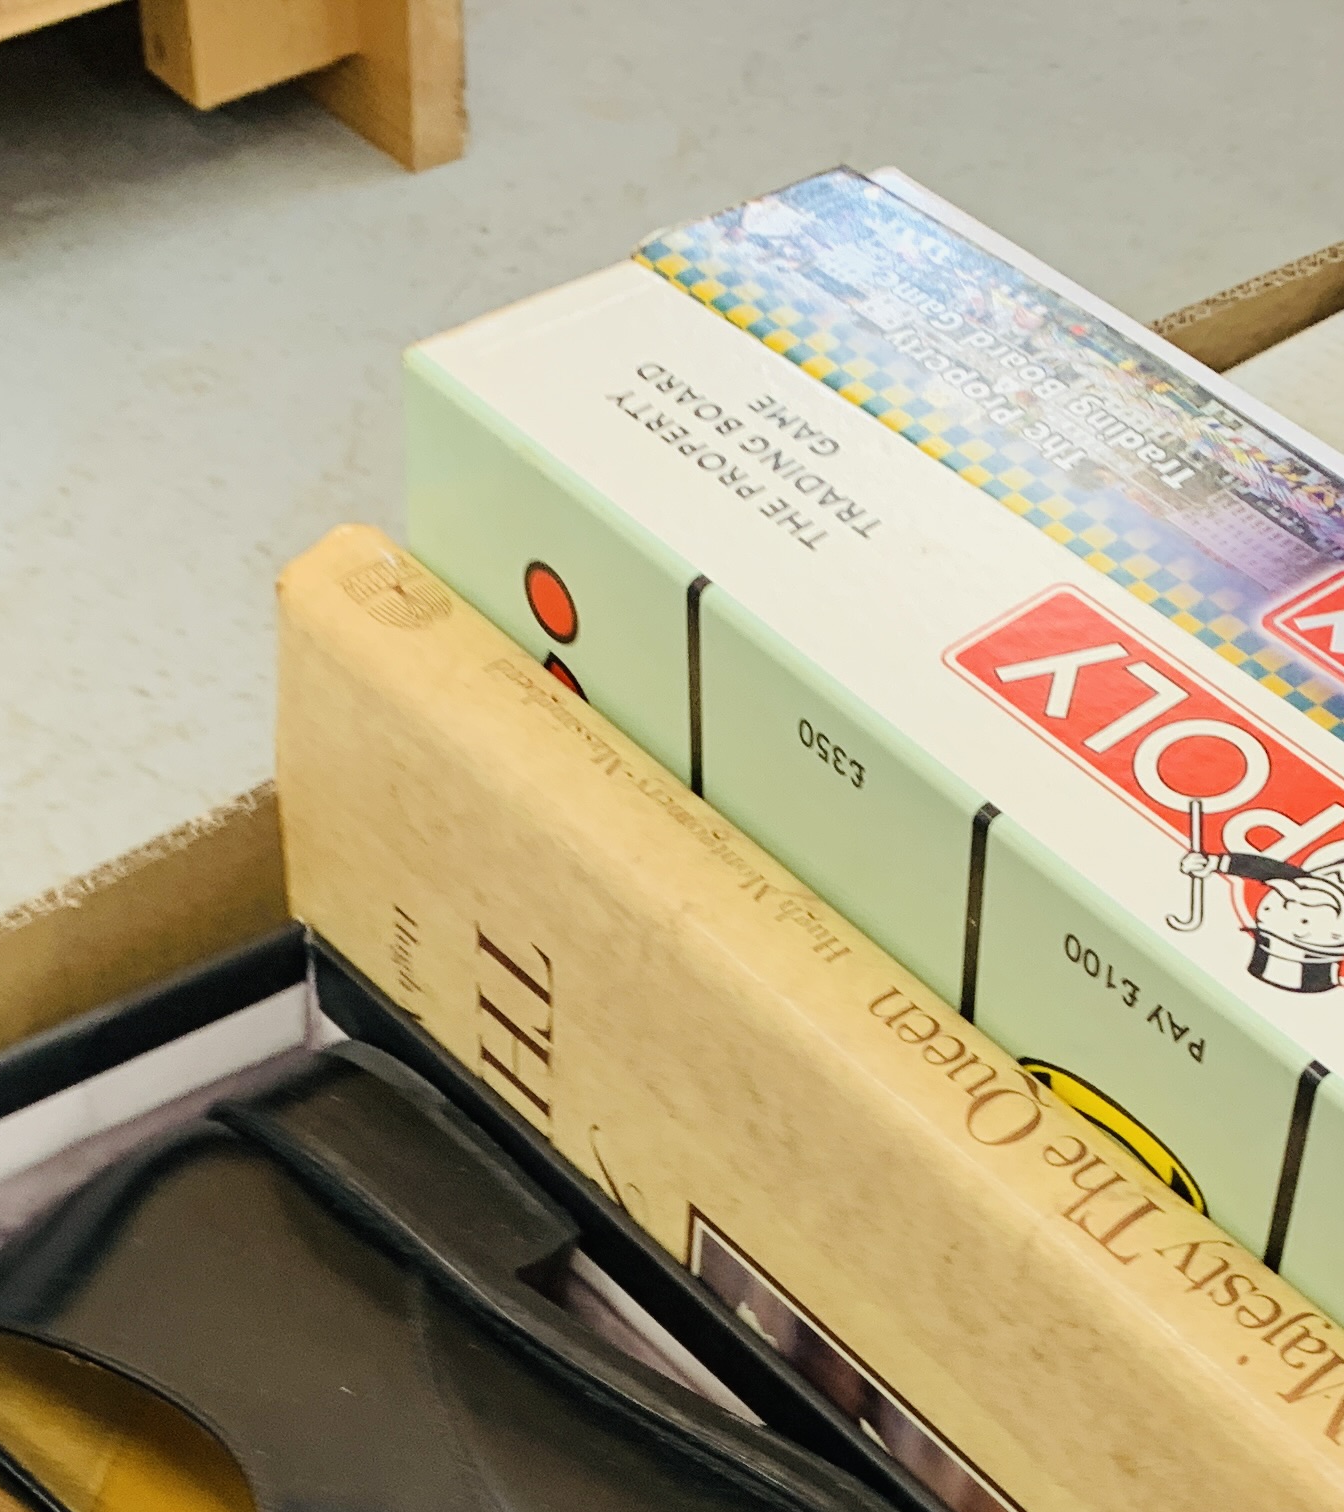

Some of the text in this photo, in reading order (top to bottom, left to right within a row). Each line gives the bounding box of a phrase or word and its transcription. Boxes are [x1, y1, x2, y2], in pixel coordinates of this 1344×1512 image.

[635, 360, 883, 540] TRADING BOARD
[745, 392, 841, 457] GAME
[869, 268, 1196, 491] Trading Board Game
[871, 318, 1091, 472] The Property
[605, 389, 830, 552] THE PROPERTY
[798, 718, 868, 789] £350
[774, 897, 854, 964] Hugh
[1064, 932, 1205, 1063] PAY £100
[868, 984, 1053, 1147] Queen
[1042, 1134, 1166, 1266] The
